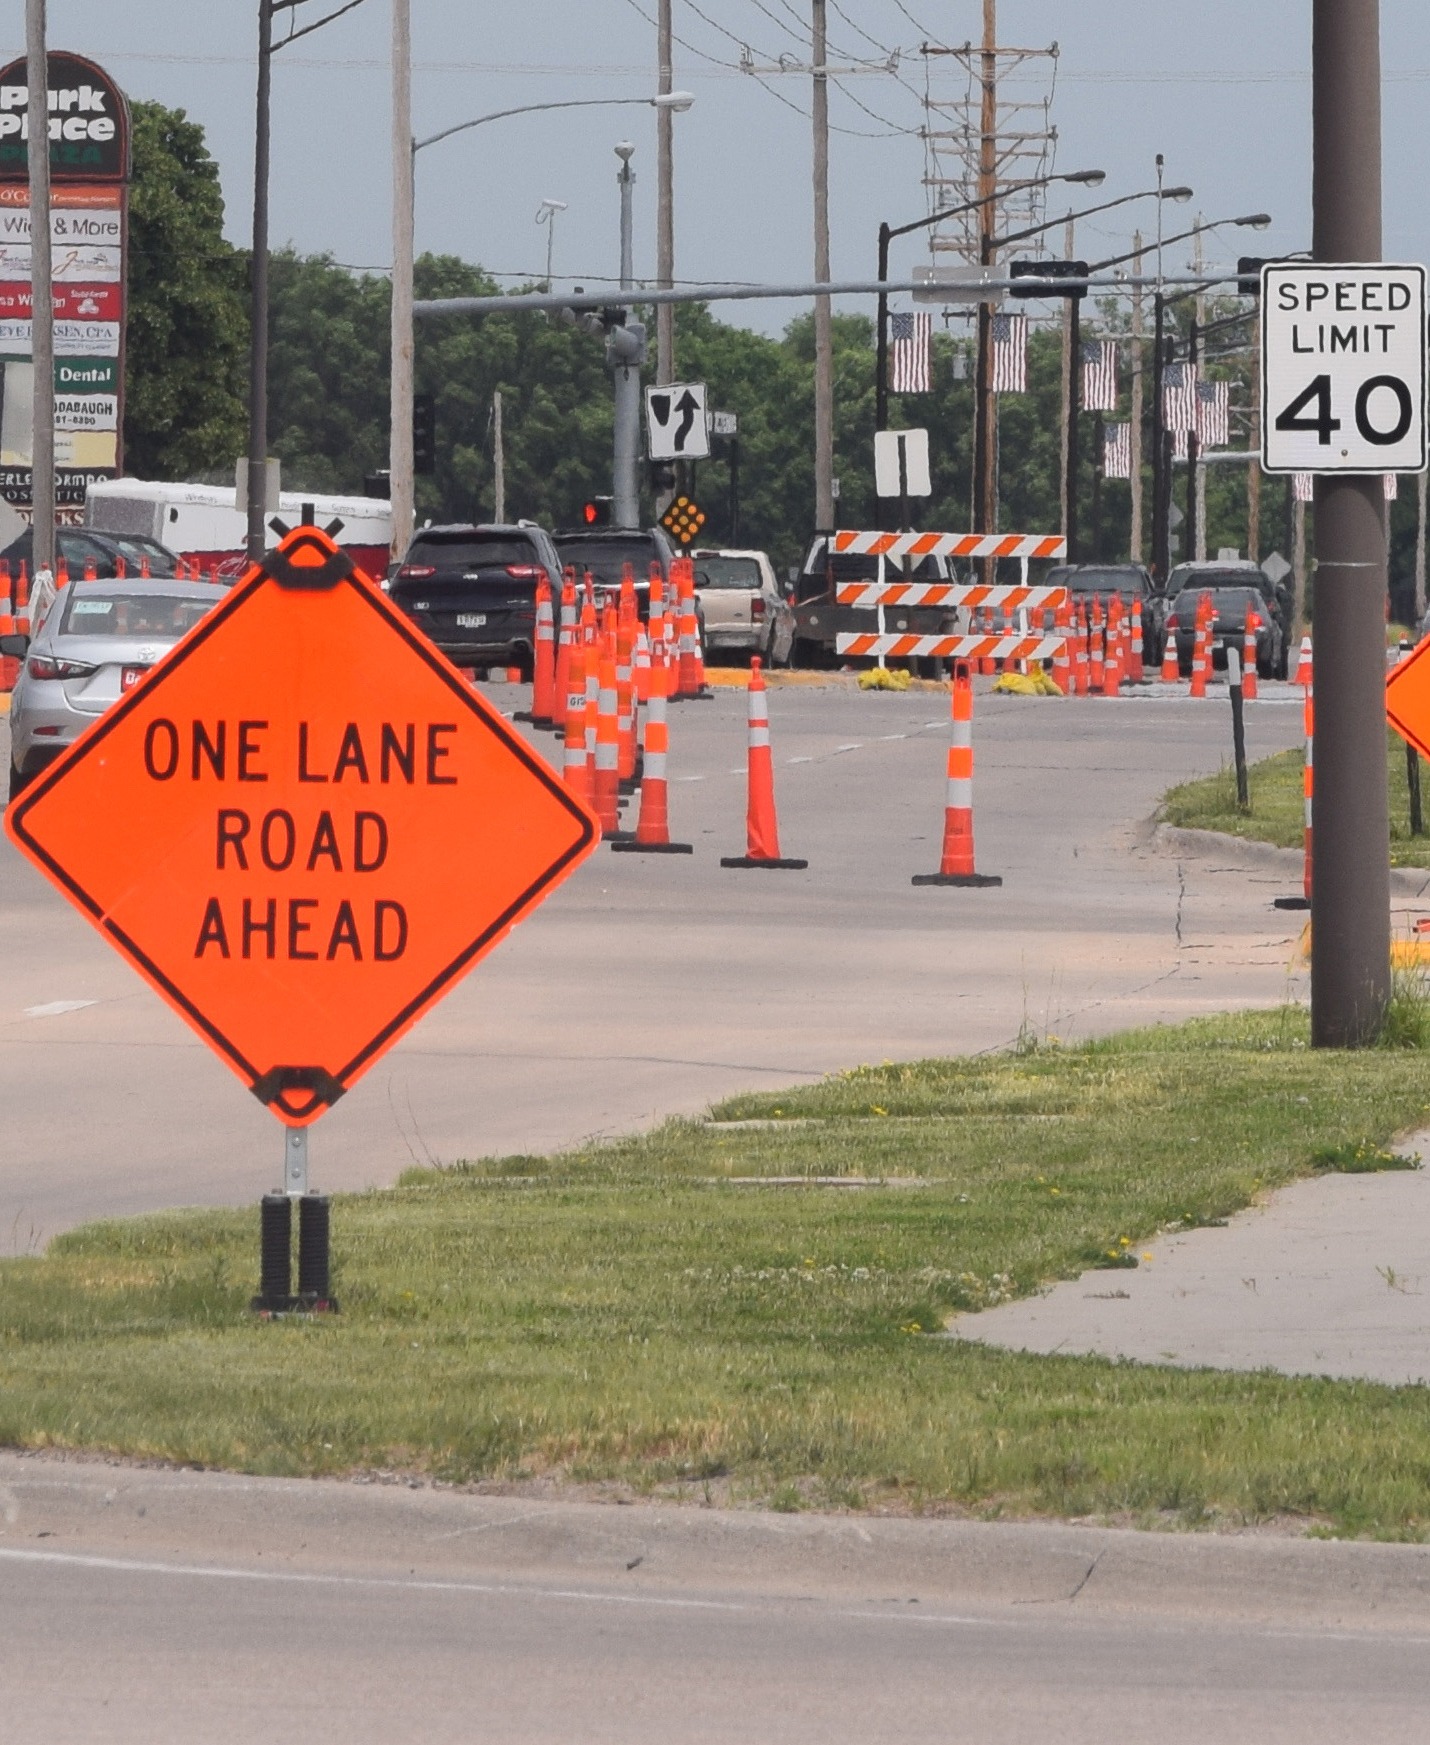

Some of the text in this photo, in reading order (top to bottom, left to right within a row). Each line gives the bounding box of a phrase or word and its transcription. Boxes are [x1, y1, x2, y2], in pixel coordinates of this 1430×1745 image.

[54, 217, 67, 235] &
[72, 218, 119, 236] More
[1278, 282, 1411, 312] SPEED
[1292, 324, 1395, 353] LIMIT
[60, 367, 111, 382] Dental
[1275, 374, 1413, 446] 40
[143, 717, 458, 785] ONE LANE
[216, 808, 388, 873] ROAD
[194, 896, 408, 962] AHEAD
